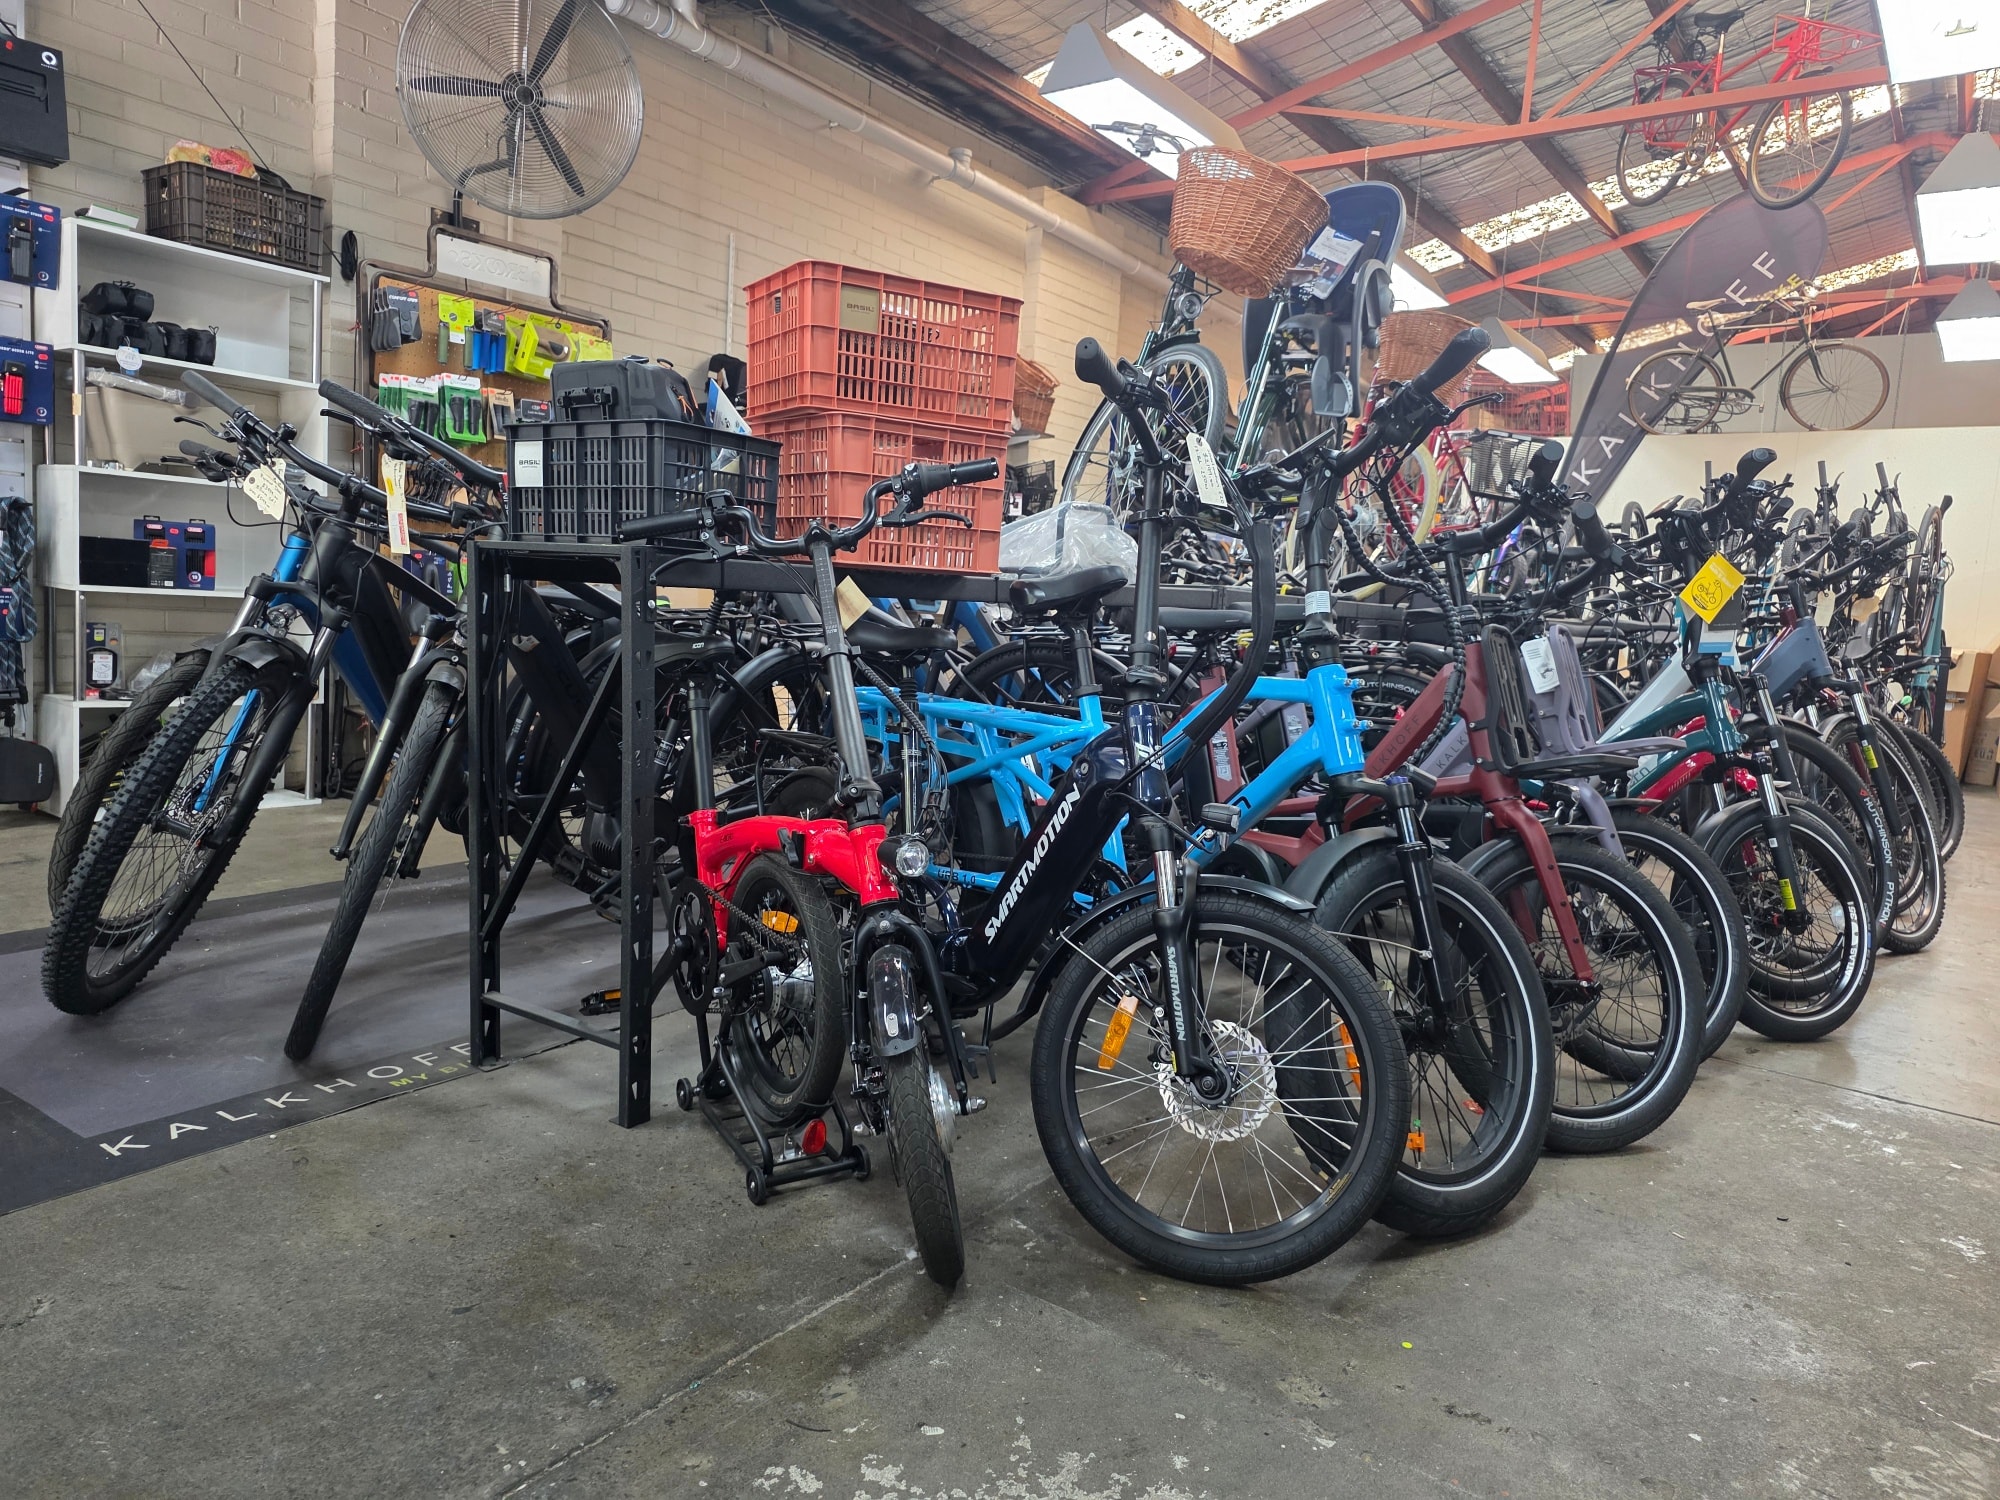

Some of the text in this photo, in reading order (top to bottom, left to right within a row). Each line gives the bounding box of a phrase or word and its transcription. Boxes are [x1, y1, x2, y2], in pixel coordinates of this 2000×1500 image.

[846, 303, 875, 313] BASIL
[1362, 681, 1420, 696] UTCHINSON
[1435, 731, 1468, 770] KALK
[1863, 797, 1893, 865] HUTCHINSON
[984, 782, 1081, 945] SMARTMOTION
[1879, 881, 1895, 925] PYTHON
[1166, 945, 1187, 1041] SMARTMOTION
[388, 1060, 471, 1087] MY BI
[99, 1042, 471, 1156] KALKHOFF
